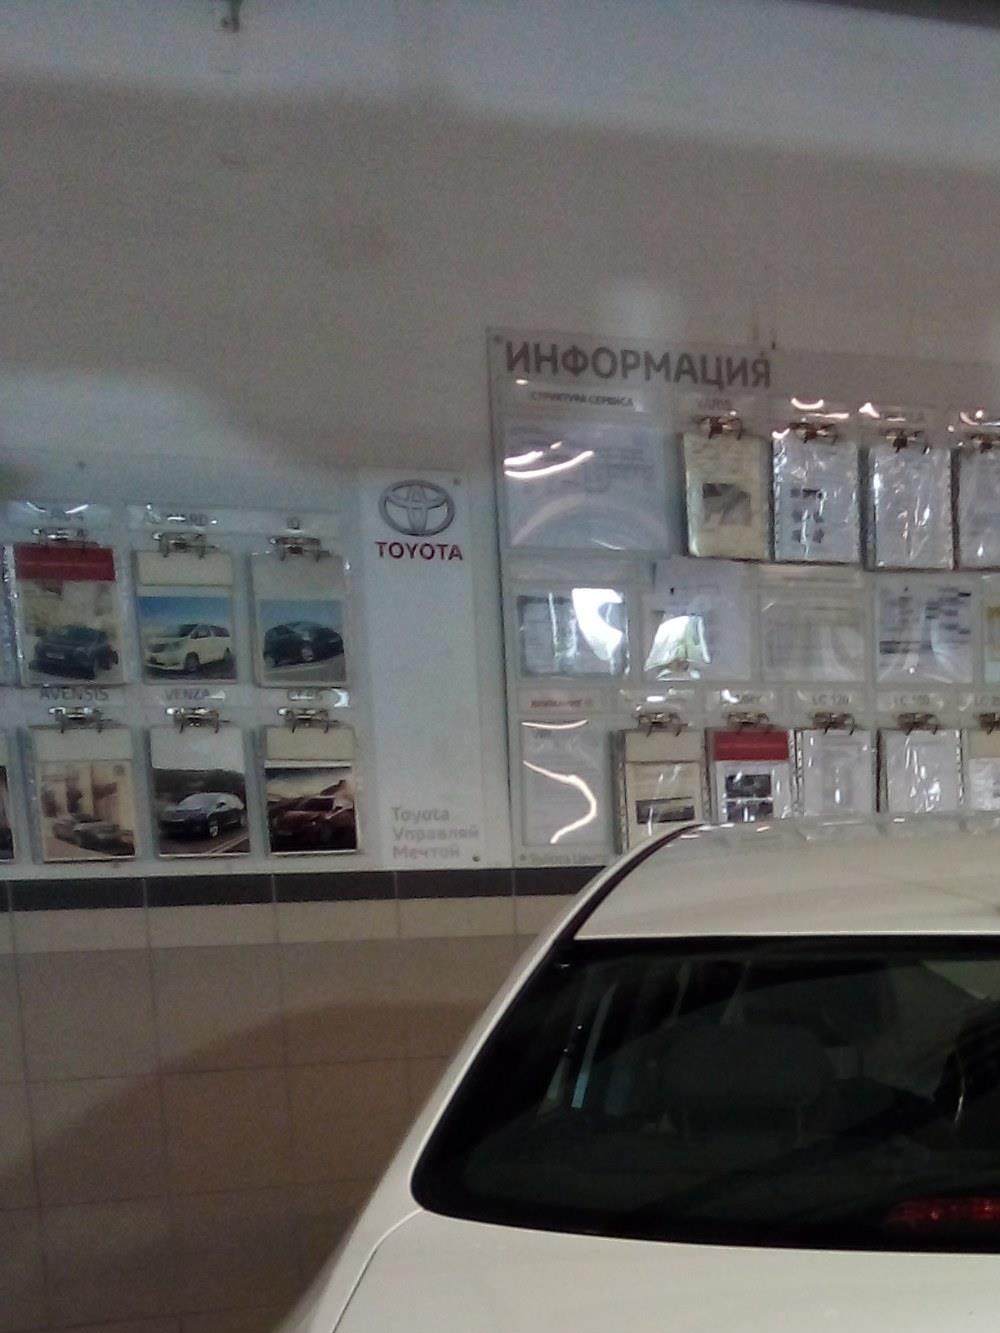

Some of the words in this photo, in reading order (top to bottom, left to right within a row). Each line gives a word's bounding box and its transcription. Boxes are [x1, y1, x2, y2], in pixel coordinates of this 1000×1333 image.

[506, 341, 771, 391] ИНФОРМАЦИЯ
[375, 541, 463, 560] TOYOTA
[391, 806, 450, 824] Toyota
[393, 823, 480, 842] Управляй
[393, 843, 460, 860] Мечтой
